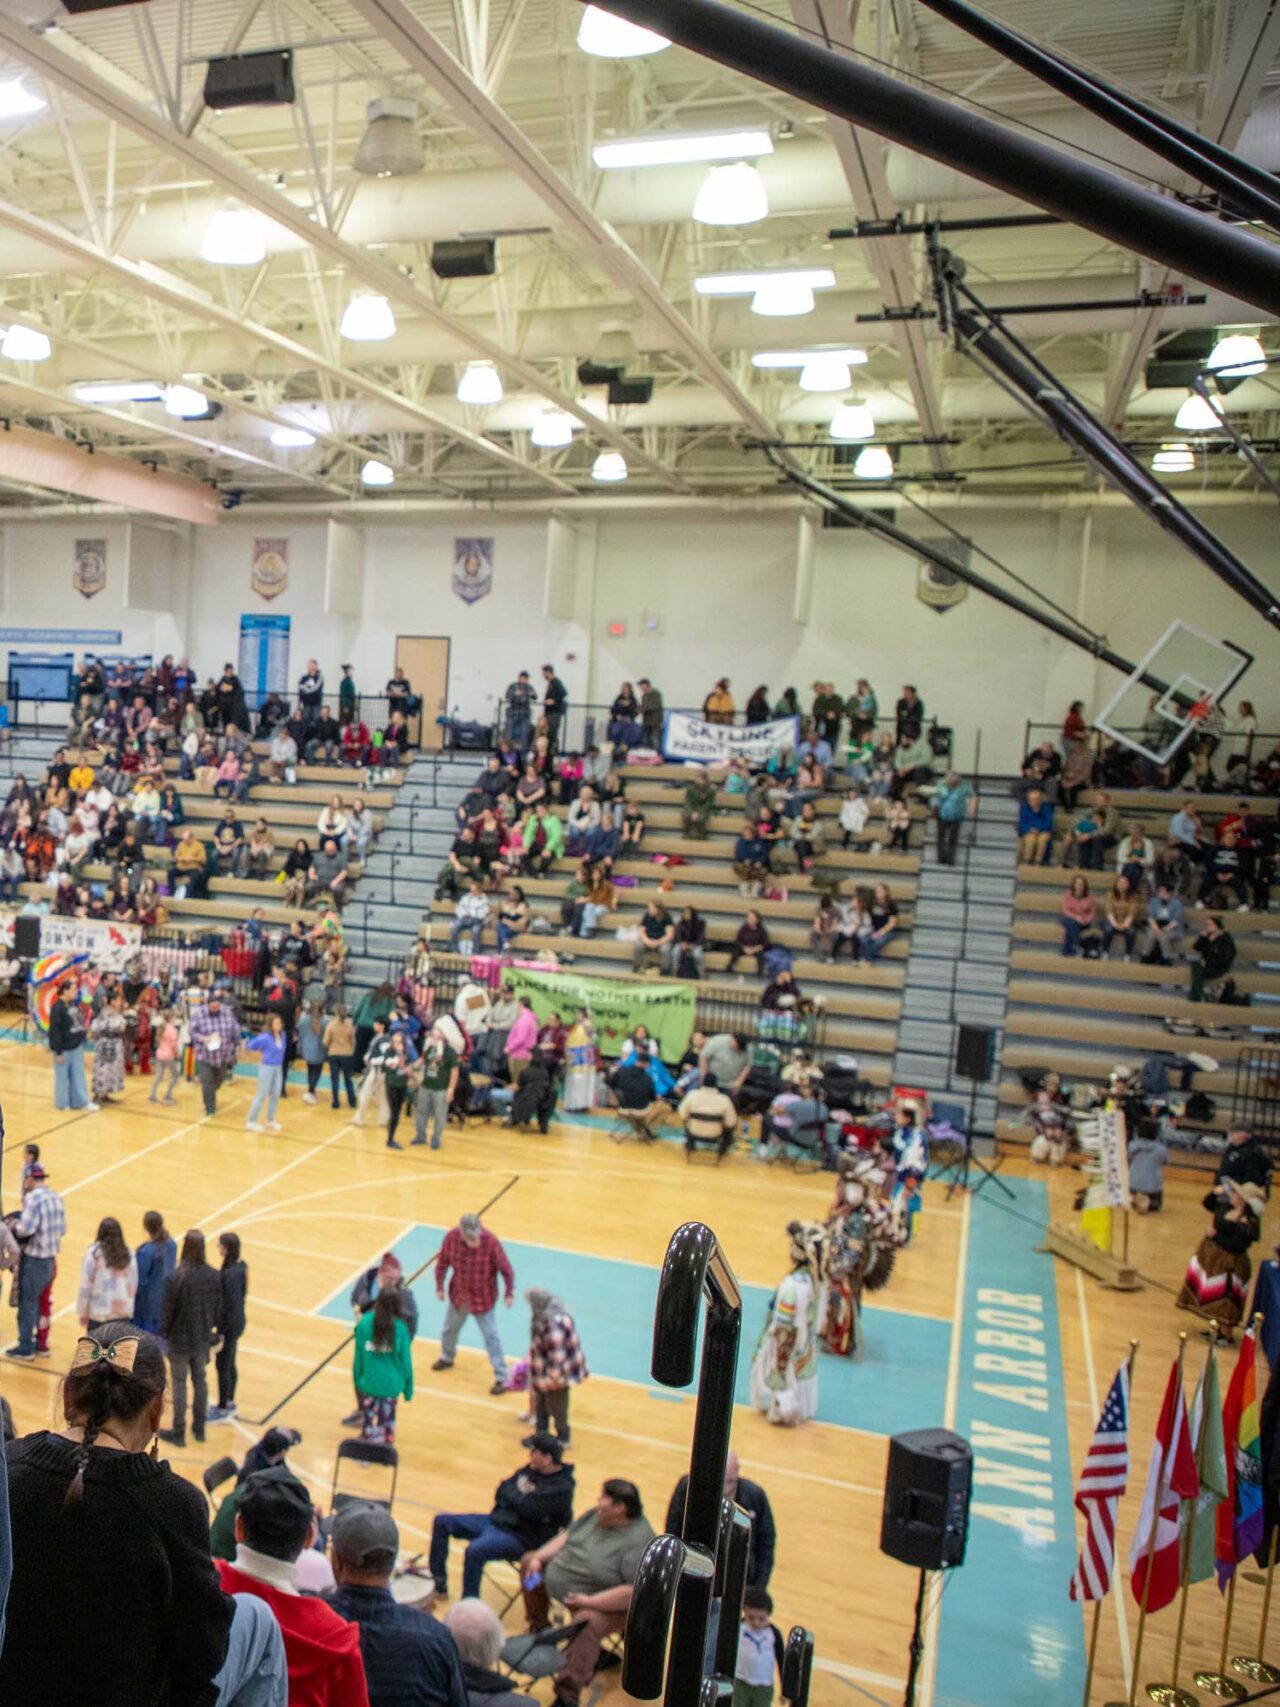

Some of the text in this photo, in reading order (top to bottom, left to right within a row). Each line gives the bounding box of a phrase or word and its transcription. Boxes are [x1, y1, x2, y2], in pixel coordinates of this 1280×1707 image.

[687, 720, 774, 742] SKYLINE
[553, 983, 579, 997] FOR
[586, 988, 641, 1002] MOTHER
[645, 994, 691, 1007] EARTH
[970, 1288, 1057, 1542] ANN ARBOR
